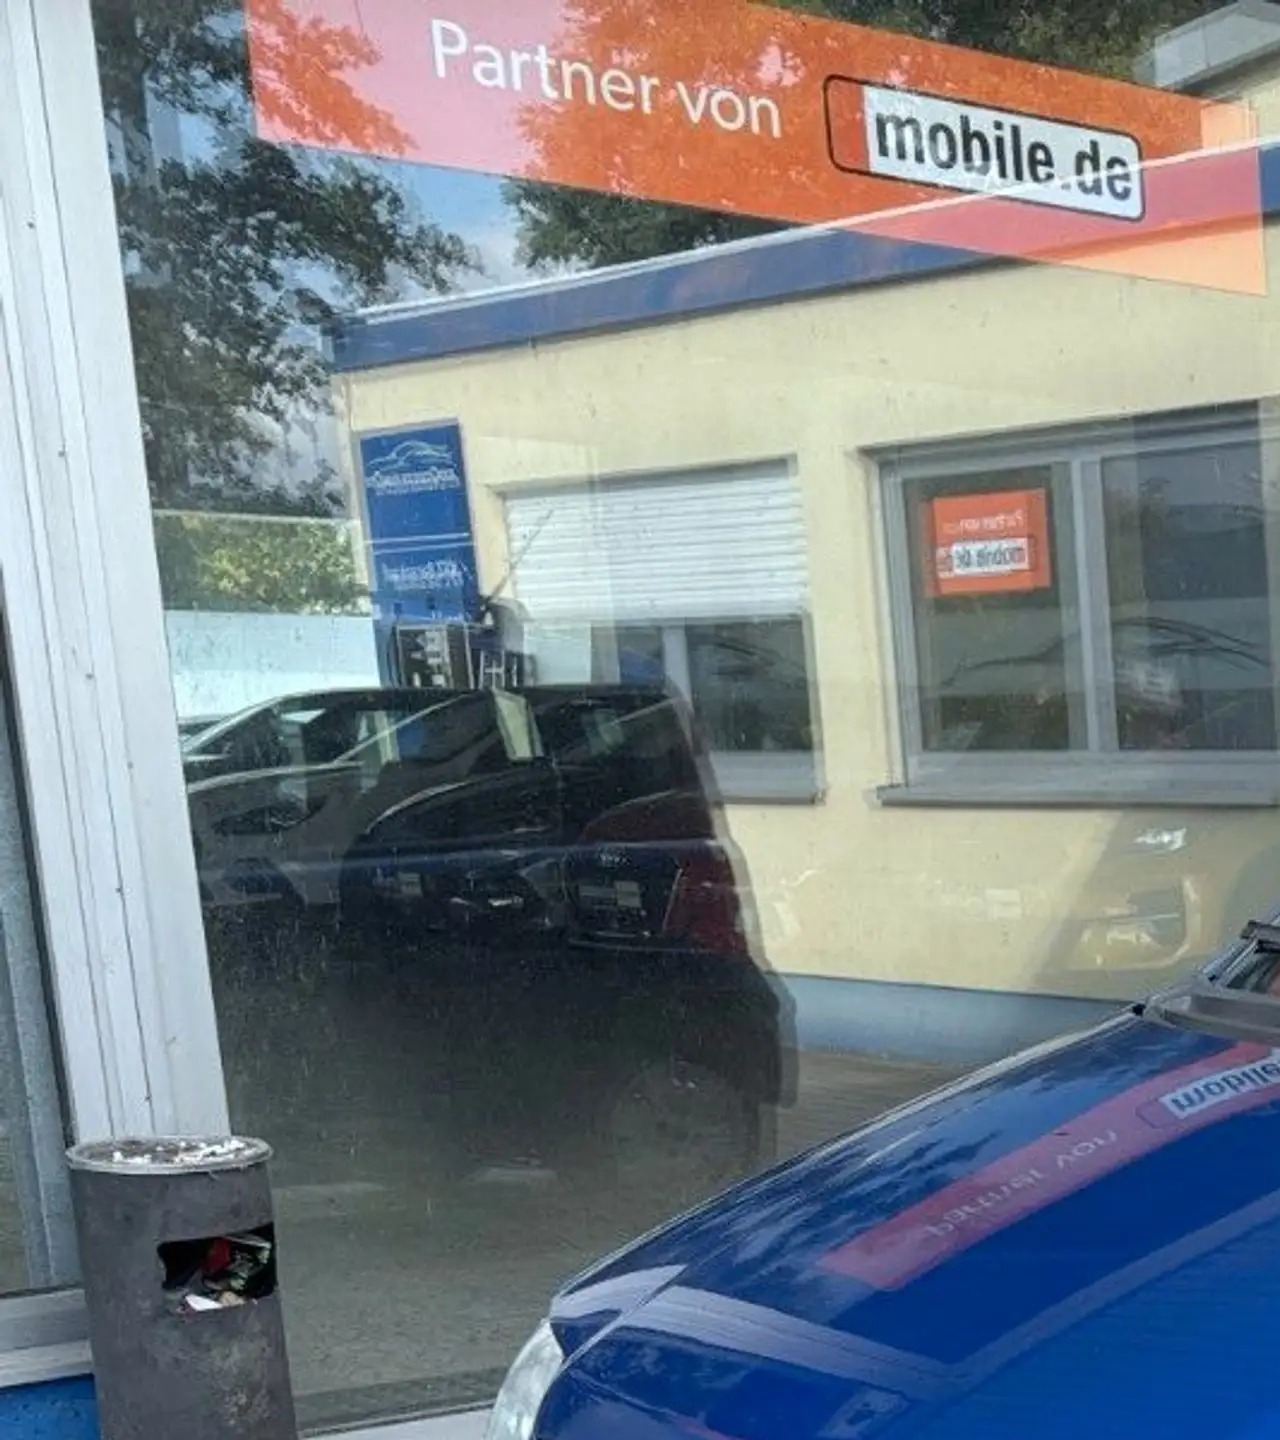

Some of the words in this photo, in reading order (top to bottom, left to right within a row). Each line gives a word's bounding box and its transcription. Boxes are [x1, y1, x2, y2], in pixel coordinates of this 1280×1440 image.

[430, 20, 659, 115] Partner
[676, 84, 781, 139] von
[875, 107, 1132, 201] mobile.de
